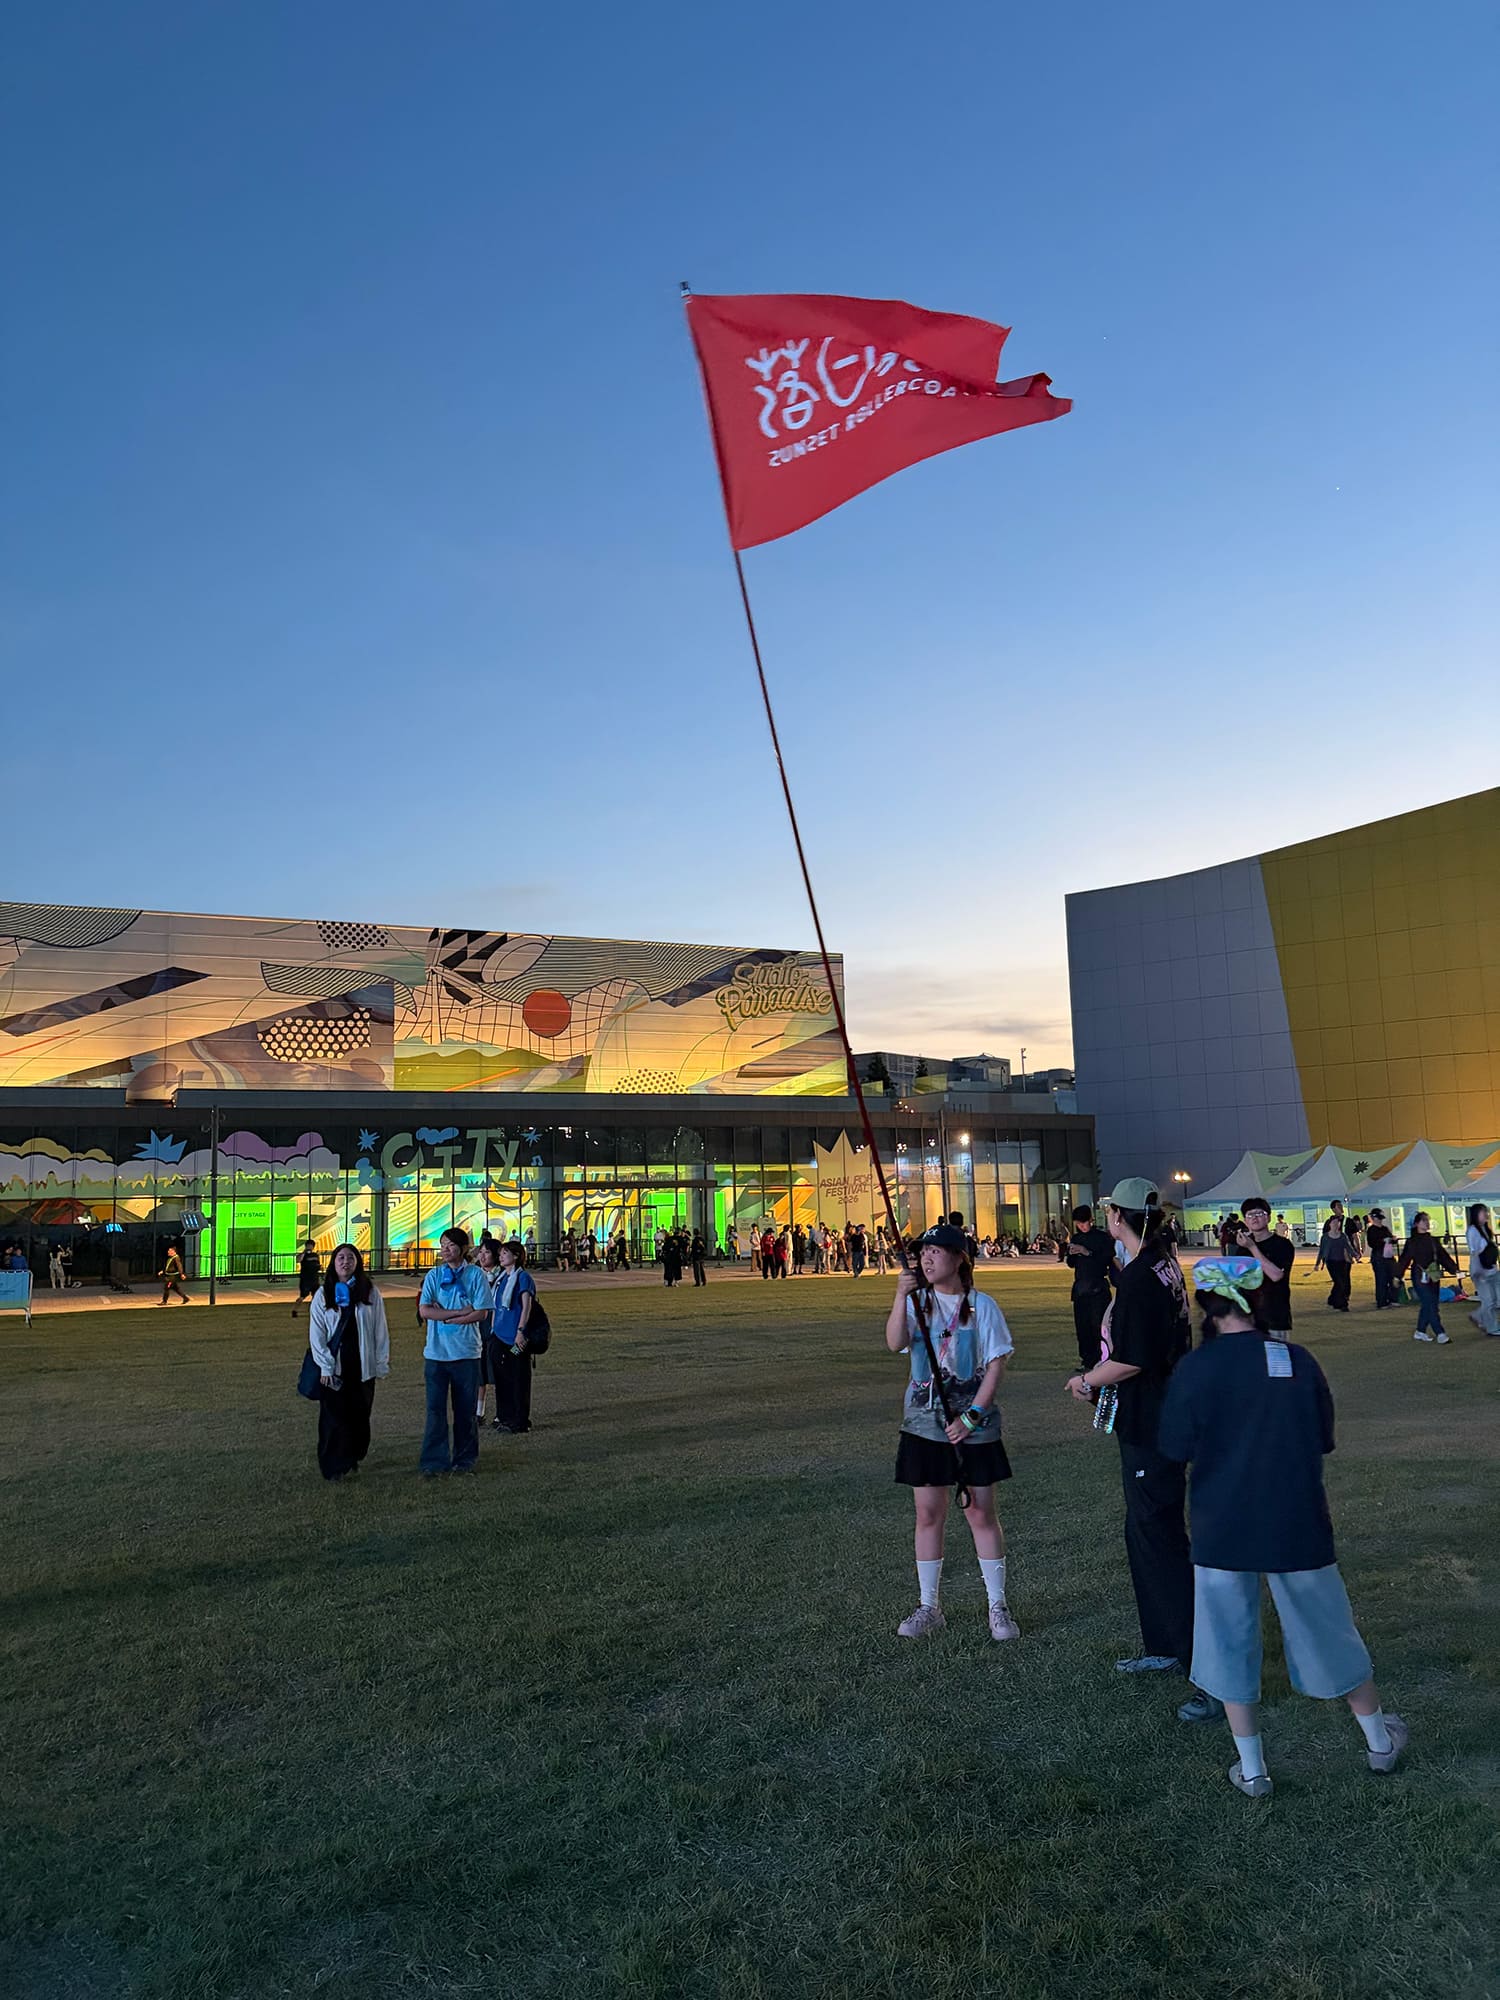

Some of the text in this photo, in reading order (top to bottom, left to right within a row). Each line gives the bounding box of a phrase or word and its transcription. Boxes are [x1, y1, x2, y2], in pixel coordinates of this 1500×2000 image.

[845, 378, 970, 431] ROLLERCOA
[716, 981, 833, 1032] Paradise
[820, 1176, 850, 1188] ASIAN
[826, 1184, 869, 1197] FESTIVAL
